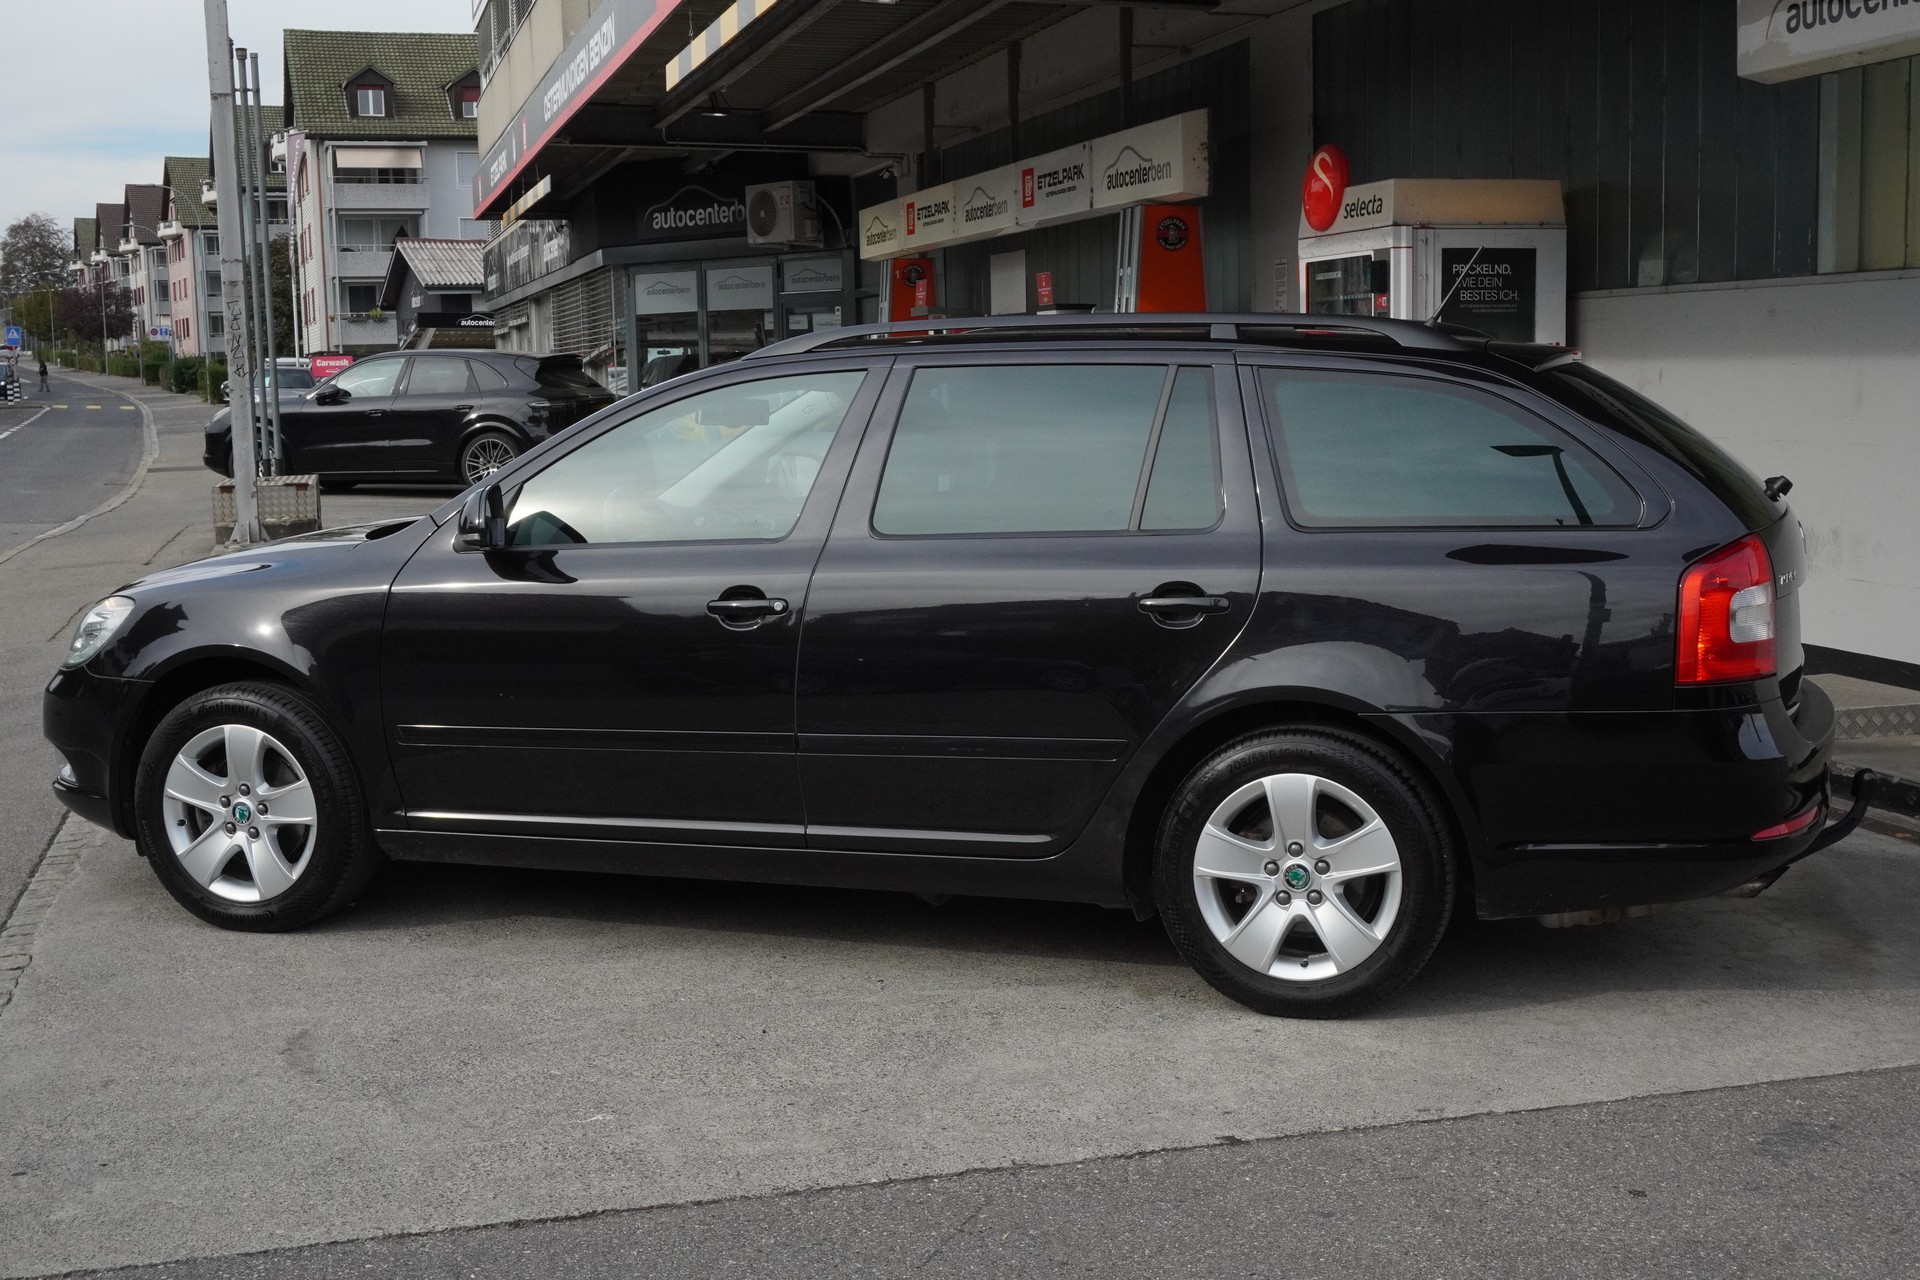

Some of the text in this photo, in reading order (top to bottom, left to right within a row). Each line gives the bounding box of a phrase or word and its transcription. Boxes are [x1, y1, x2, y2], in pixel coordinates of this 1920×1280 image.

[1786, 0, 1920, 34] autoc
[589, 12, 615, 71] BENZIN
[1037, 163, 1084, 190] ETZELPARK
[1107, 159, 1171, 190] autocenterbern
[917, 200, 950, 221] ETZELPARK
[965, 199, 1008, 223] autocenterbern
[1343, 194, 1383, 219] selecta
[1452, 263, 1512, 275] PRCKELND,
[1478, 277, 1502, 288] DEIN
[1460, 290, 1520, 301] BESTES ICH.
[316, 358, 349, 367] Carwash
